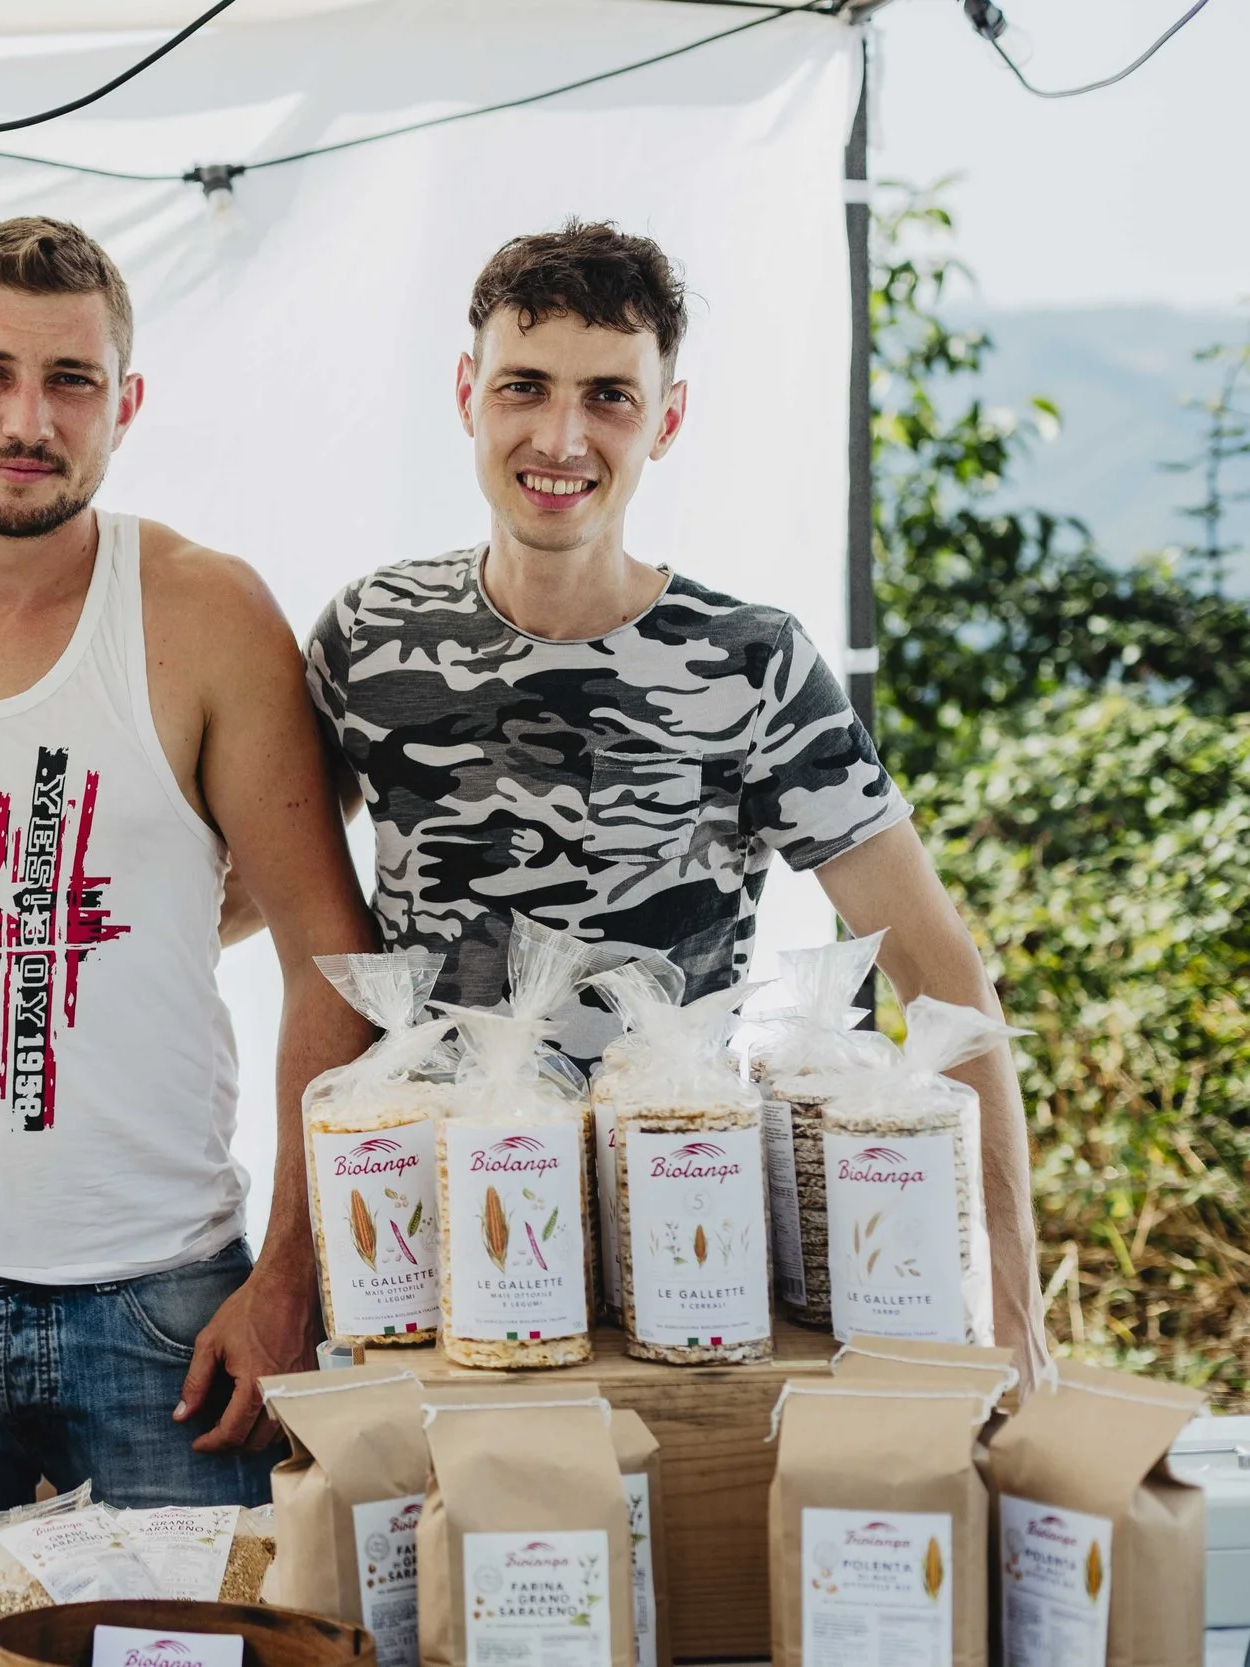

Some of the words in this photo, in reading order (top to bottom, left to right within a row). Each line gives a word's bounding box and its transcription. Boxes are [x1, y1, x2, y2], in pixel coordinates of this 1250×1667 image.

[13, 1032, 46, 1120] 1958
[333, 1153, 419, 1177] Biolanga
[470, 1150, 559, 1178] Biolanga
[650, 1157, 741, 1184] Biolanga
[837, 1159, 925, 1190] Biolanga
[692, 1193, 704, 1210] 5
[352, 1279, 365, 1288] LE
[371, 1268, 434, 1287] GALLETTE
[477, 1280, 491, 1289] LE
[498, 1277, 563, 1290] GALLETTE
[385, 1294, 415, 1303] LEGUMI
[658, 1289, 671, 1299] LE
[679, 1286, 746, 1299] GALLETTE
[848, 1292, 859, 1302] LE
[864, 1294, 932, 1306] GALLETTE
[139, 1525, 204, 1533] SARACENO
[843, 1559, 913, 1574] POLENTA
[511, 1581, 565, 1592] FARINA
[518, 1594, 571, 1604] GRANO
[499, 1605, 578, 1617] SARACENO
